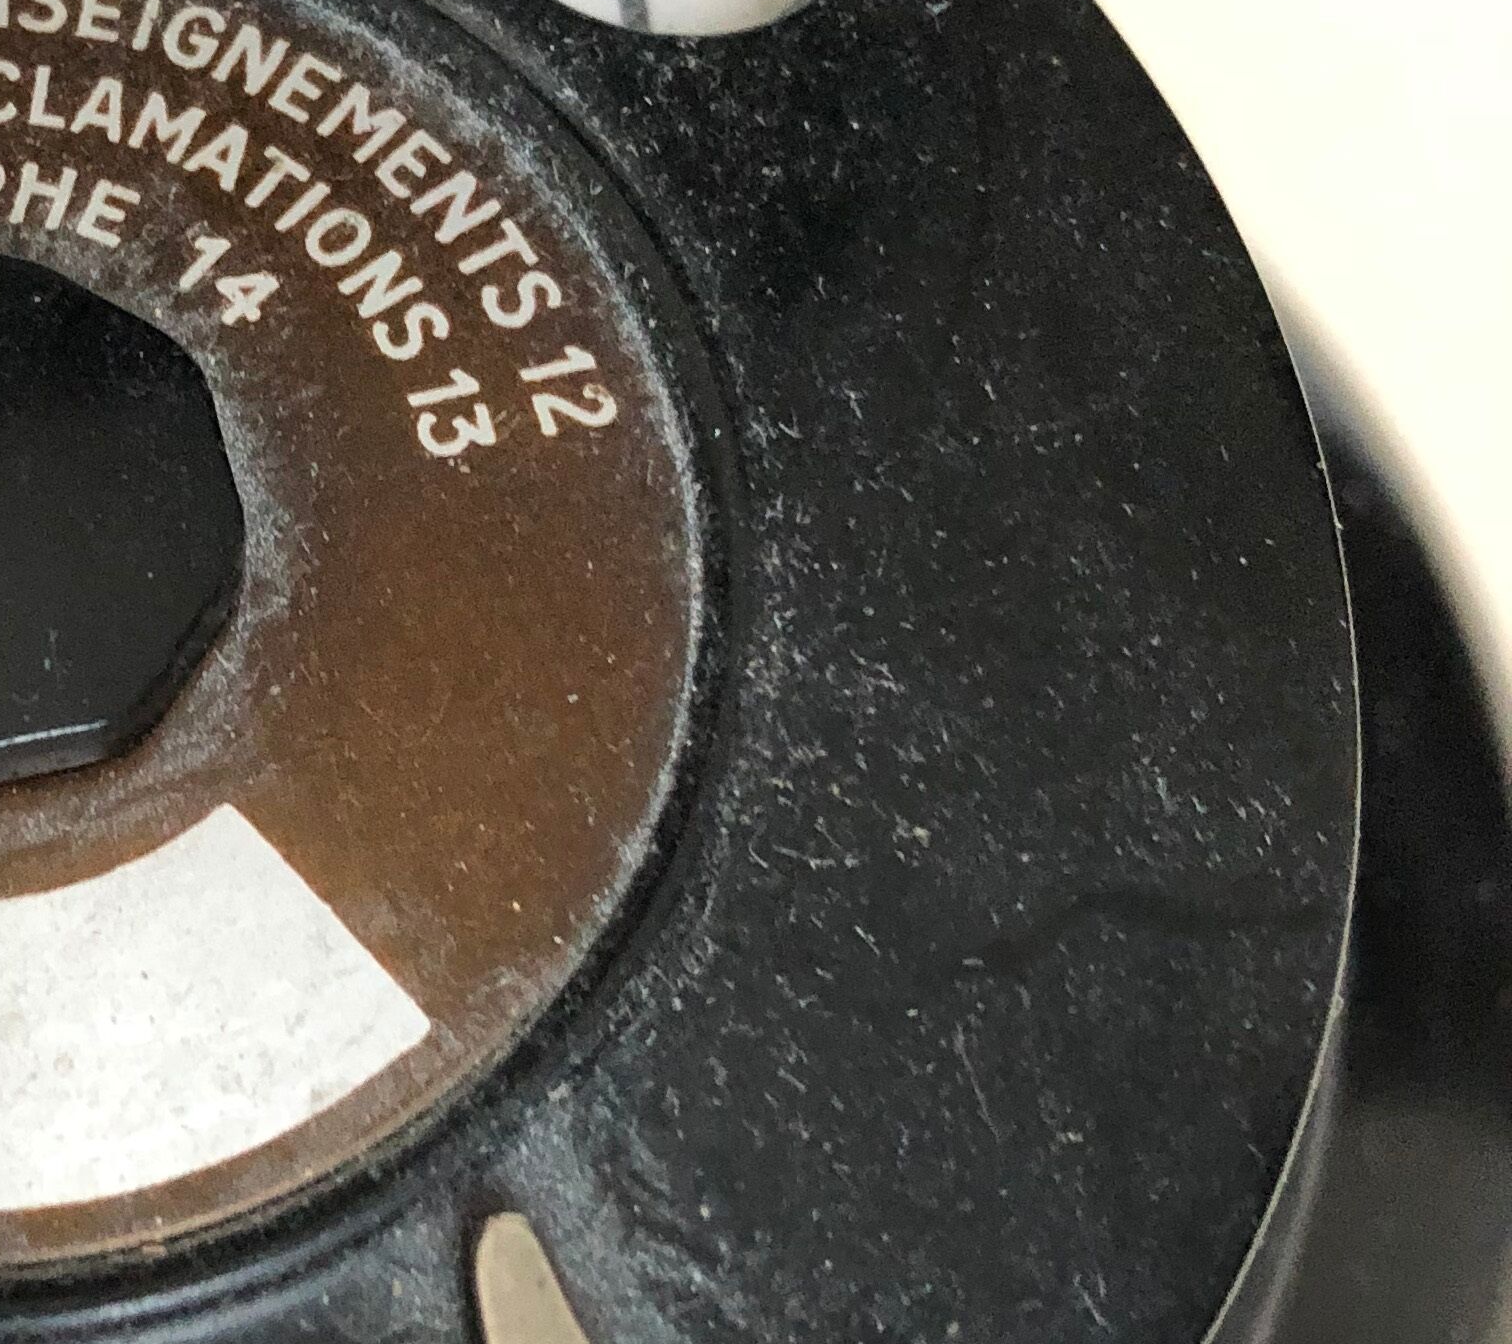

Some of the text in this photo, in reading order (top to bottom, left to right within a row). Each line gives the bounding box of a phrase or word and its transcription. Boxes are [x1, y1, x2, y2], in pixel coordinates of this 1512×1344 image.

[178, 234, 281, 327] 14
[407, 367, 497, 459] 13
[518, 344, 619, 439] 12
